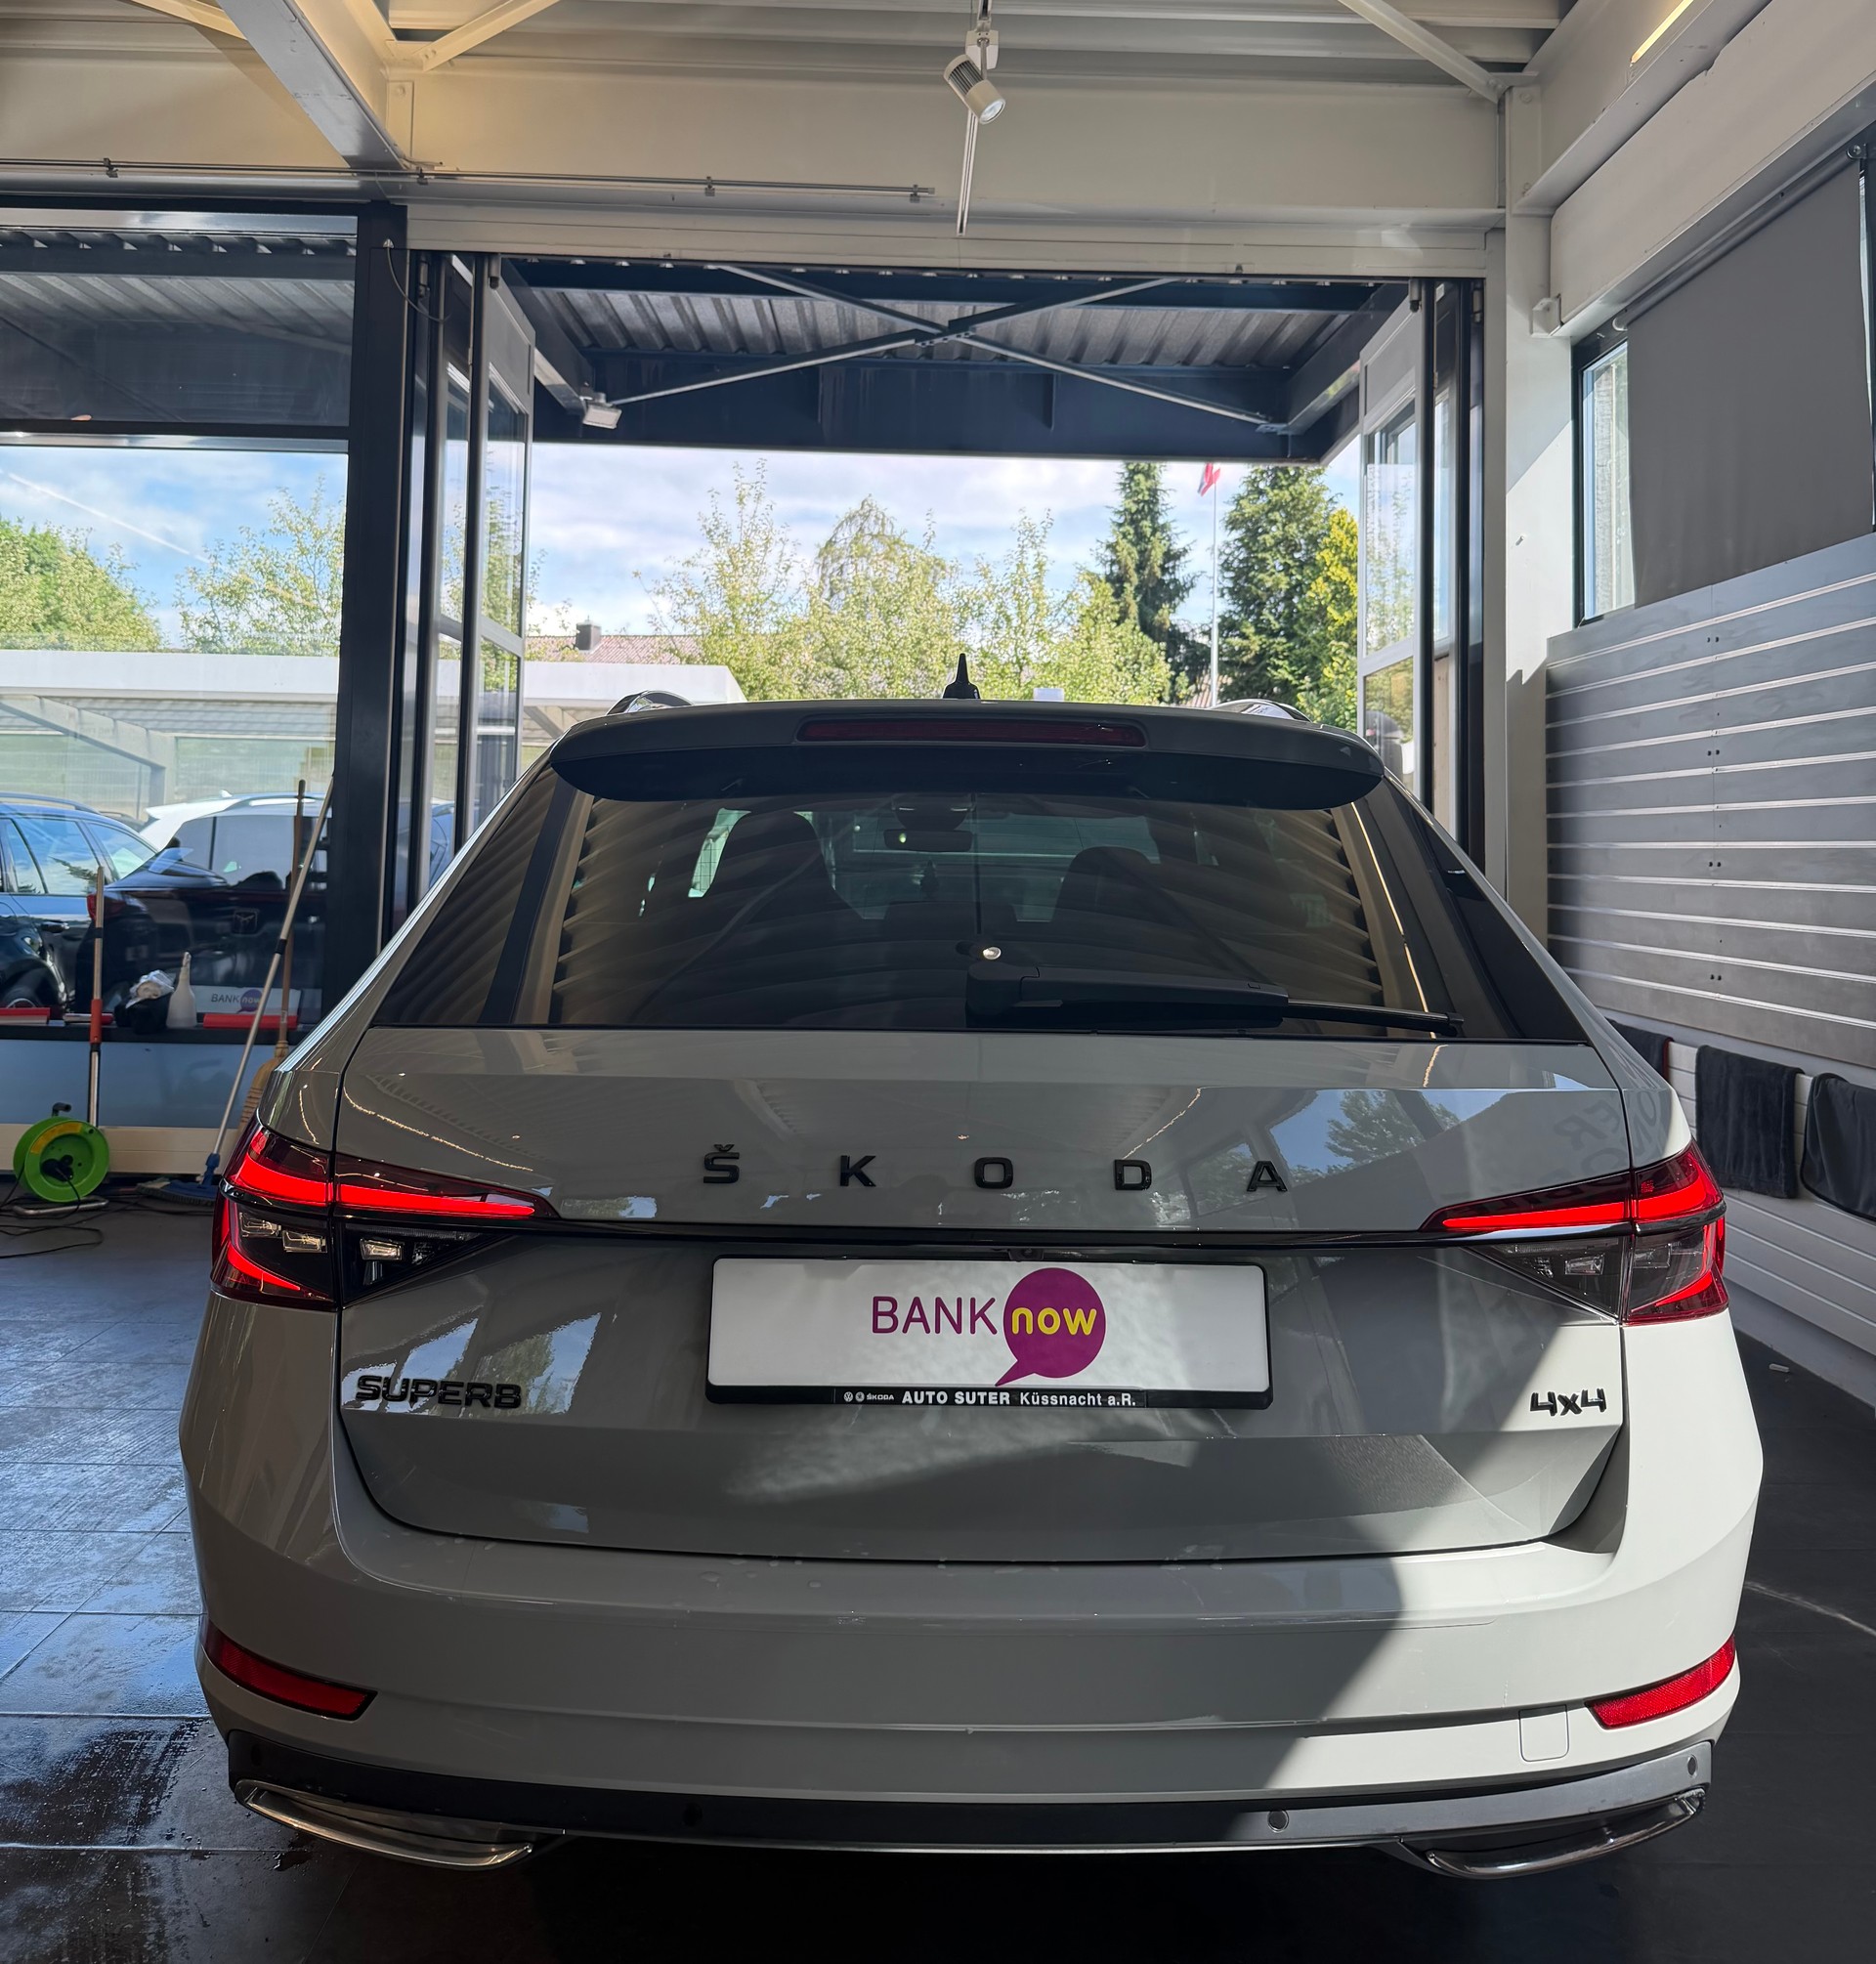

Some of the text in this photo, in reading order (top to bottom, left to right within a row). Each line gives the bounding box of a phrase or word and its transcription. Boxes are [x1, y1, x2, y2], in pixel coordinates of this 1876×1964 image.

[211, 993, 239, 1003] BANK
[703, 1143, 1288, 1193] ŠKODA
[872, 1296, 1097, 1336] BANK now
[356, 1374, 522, 1409] SUPERB
[902, 1390, 948, 1404] AUTO
[954, 1391, 1010, 1405] SUTER
[1020, 1392, 1102, 1406] Küssnacht
[1107, 1392, 1136, 1406] a.R.
[1529, 1388, 1607, 1417] 4x4
